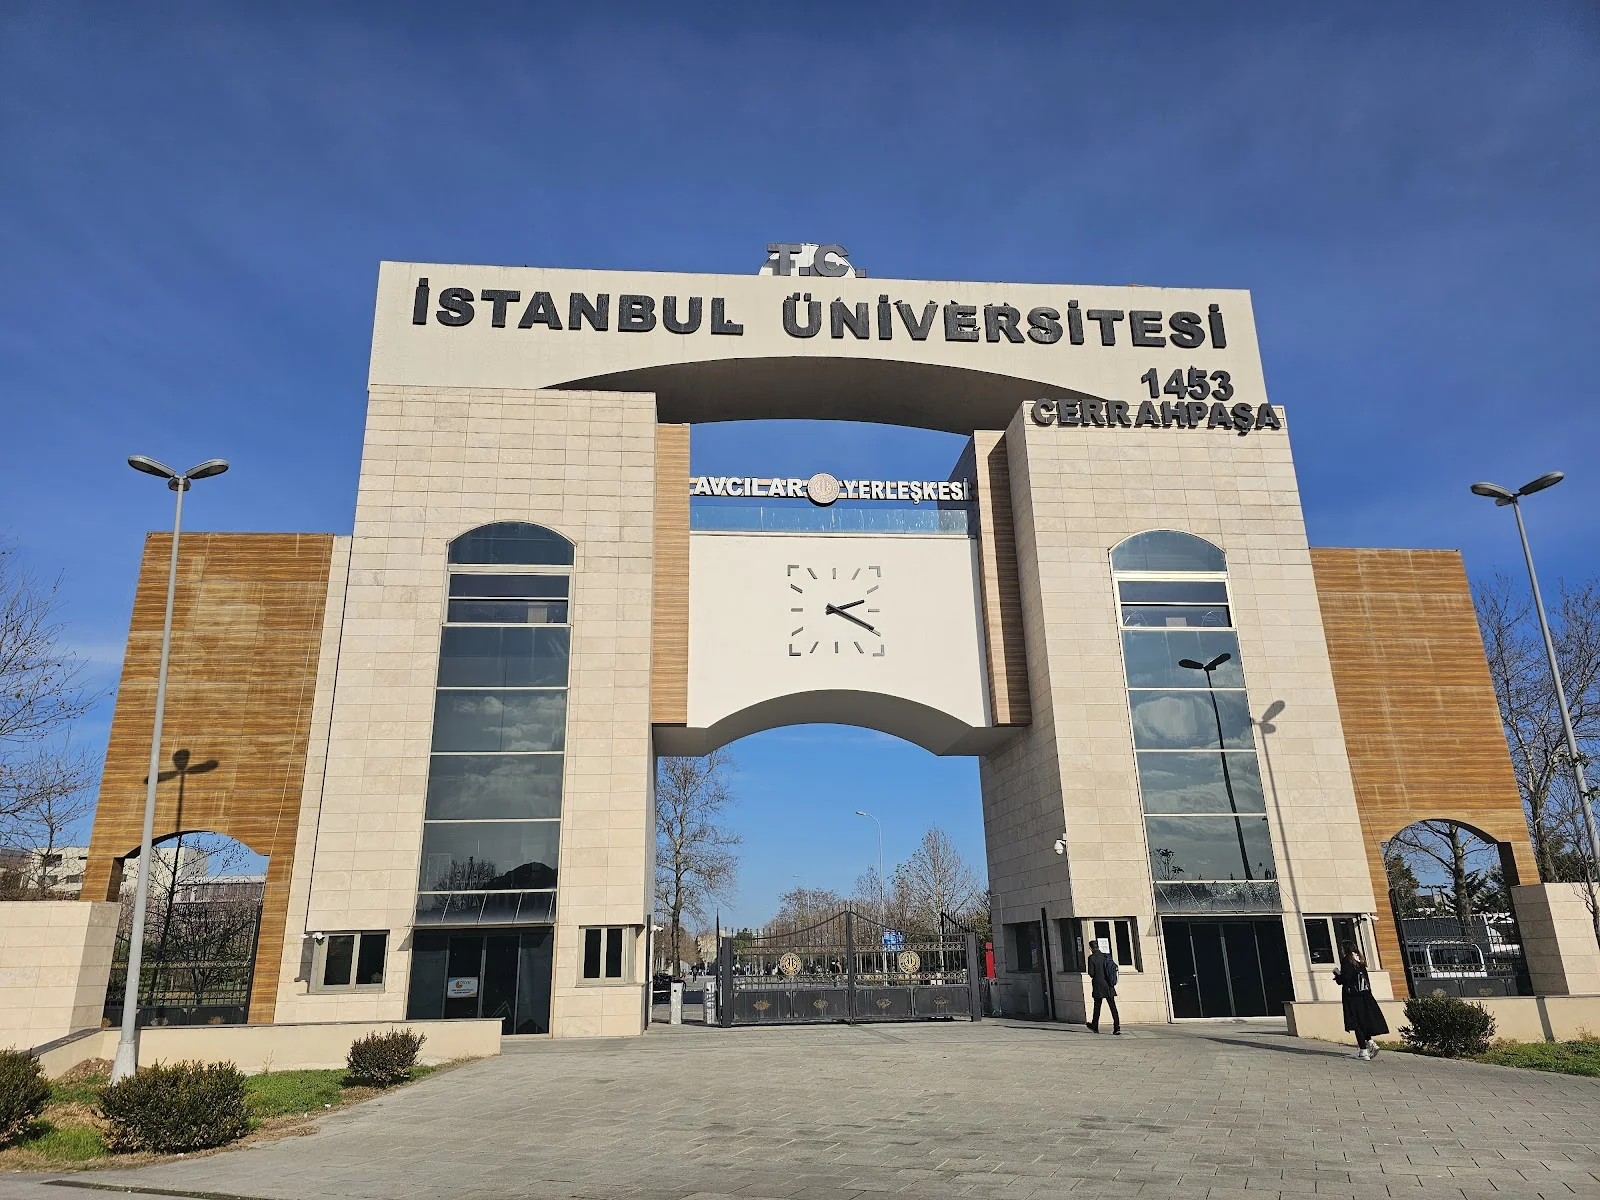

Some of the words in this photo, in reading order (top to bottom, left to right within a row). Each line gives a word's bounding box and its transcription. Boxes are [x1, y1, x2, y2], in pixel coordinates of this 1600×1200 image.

[767, 243, 867, 278] T.C.
[412, 277, 744, 336] İSTANBUL
[783, 291, 1227, 349] ÜNİVERSİTESİ
[1141, 367, 1234, 401] 1453
[1031, 398, 1282, 436] CERRAHPAŞA
[693, 476, 804, 498] AVCILAR
[843, 477, 969, 504] YERLEŞKESİ
